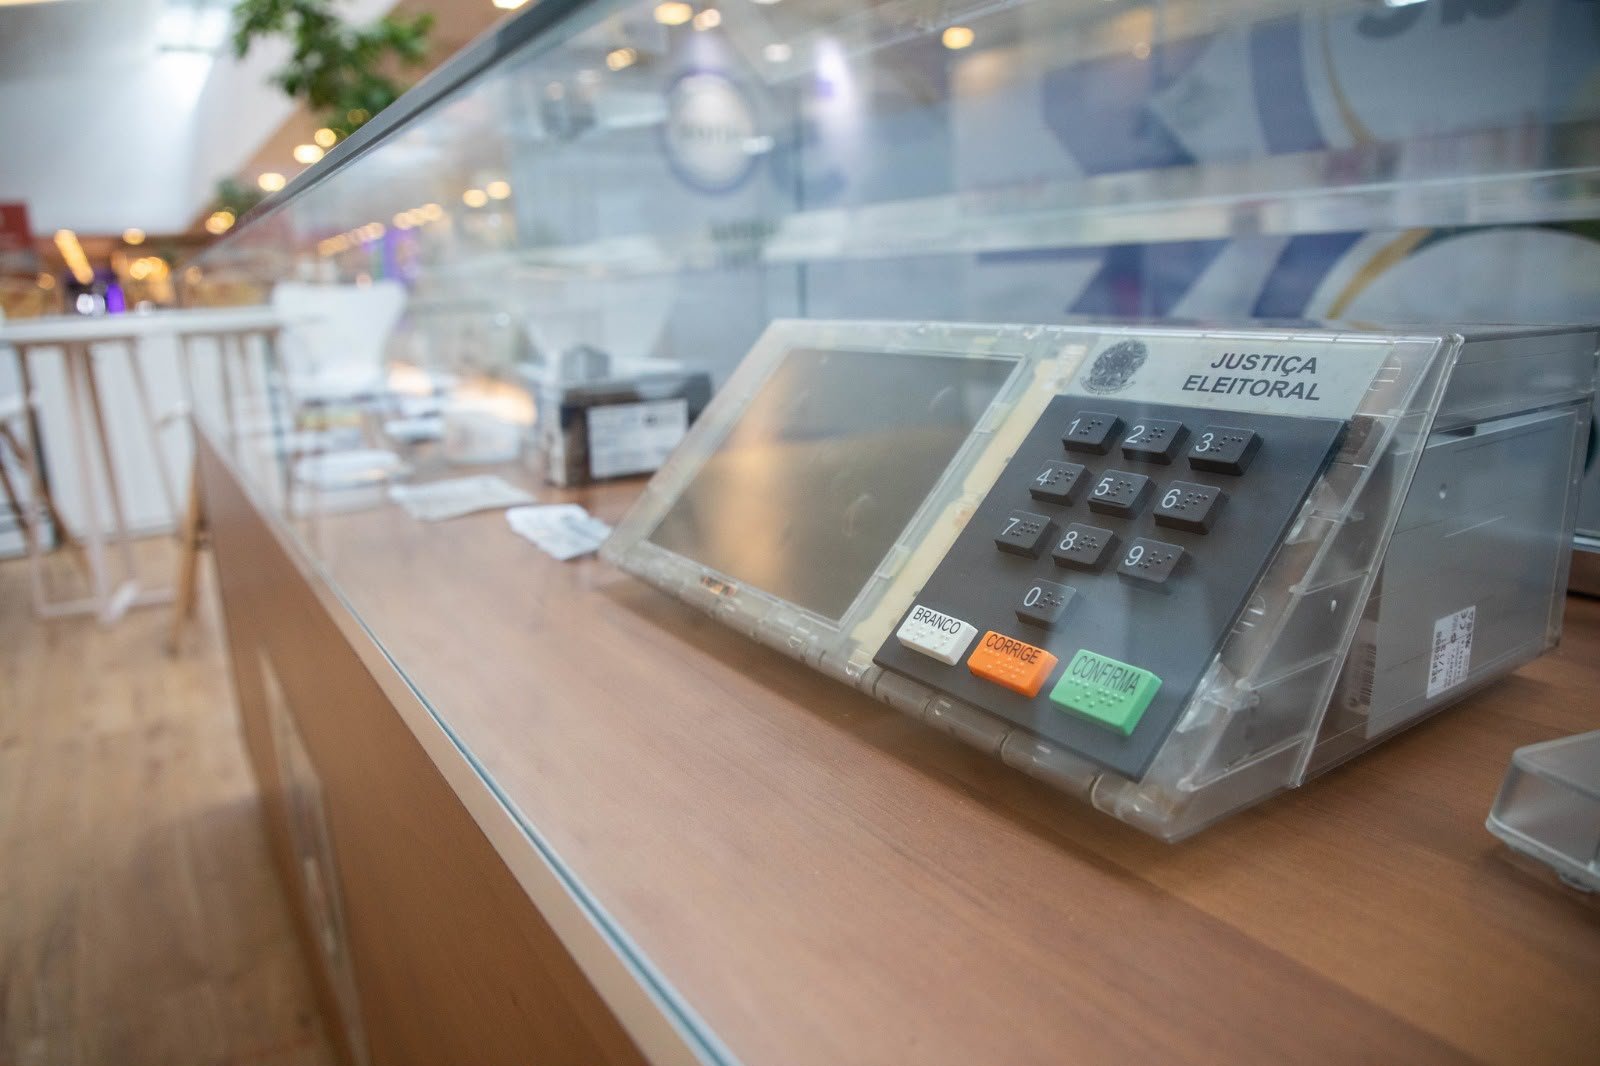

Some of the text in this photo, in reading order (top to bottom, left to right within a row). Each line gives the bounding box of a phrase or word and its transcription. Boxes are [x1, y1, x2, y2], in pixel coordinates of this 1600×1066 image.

[1210, 352, 1317, 375] JUSTIÇA
[1182, 375, 1321, 401] ELEITORAL
[1069, 418, 1081, 436] 1
[1125, 425, 1145, 444] 2
[1195, 433, 1214, 452] 3
[1036, 469, 1053, 487] 4
[1094, 477, 1114, 496] 5
[1161, 488, 1181, 508] 6
[1001, 517, 1020, 536] 7
[1060, 531, 1078, 551] 8
[1124, 545, 1145, 566] 9
[1023, 586, 1041, 606] 0
[913, 606, 962, 635] BRANCO
[985, 633, 1042, 665] CORRIGE
[1072, 655, 1140, 696] CONFIRMA
